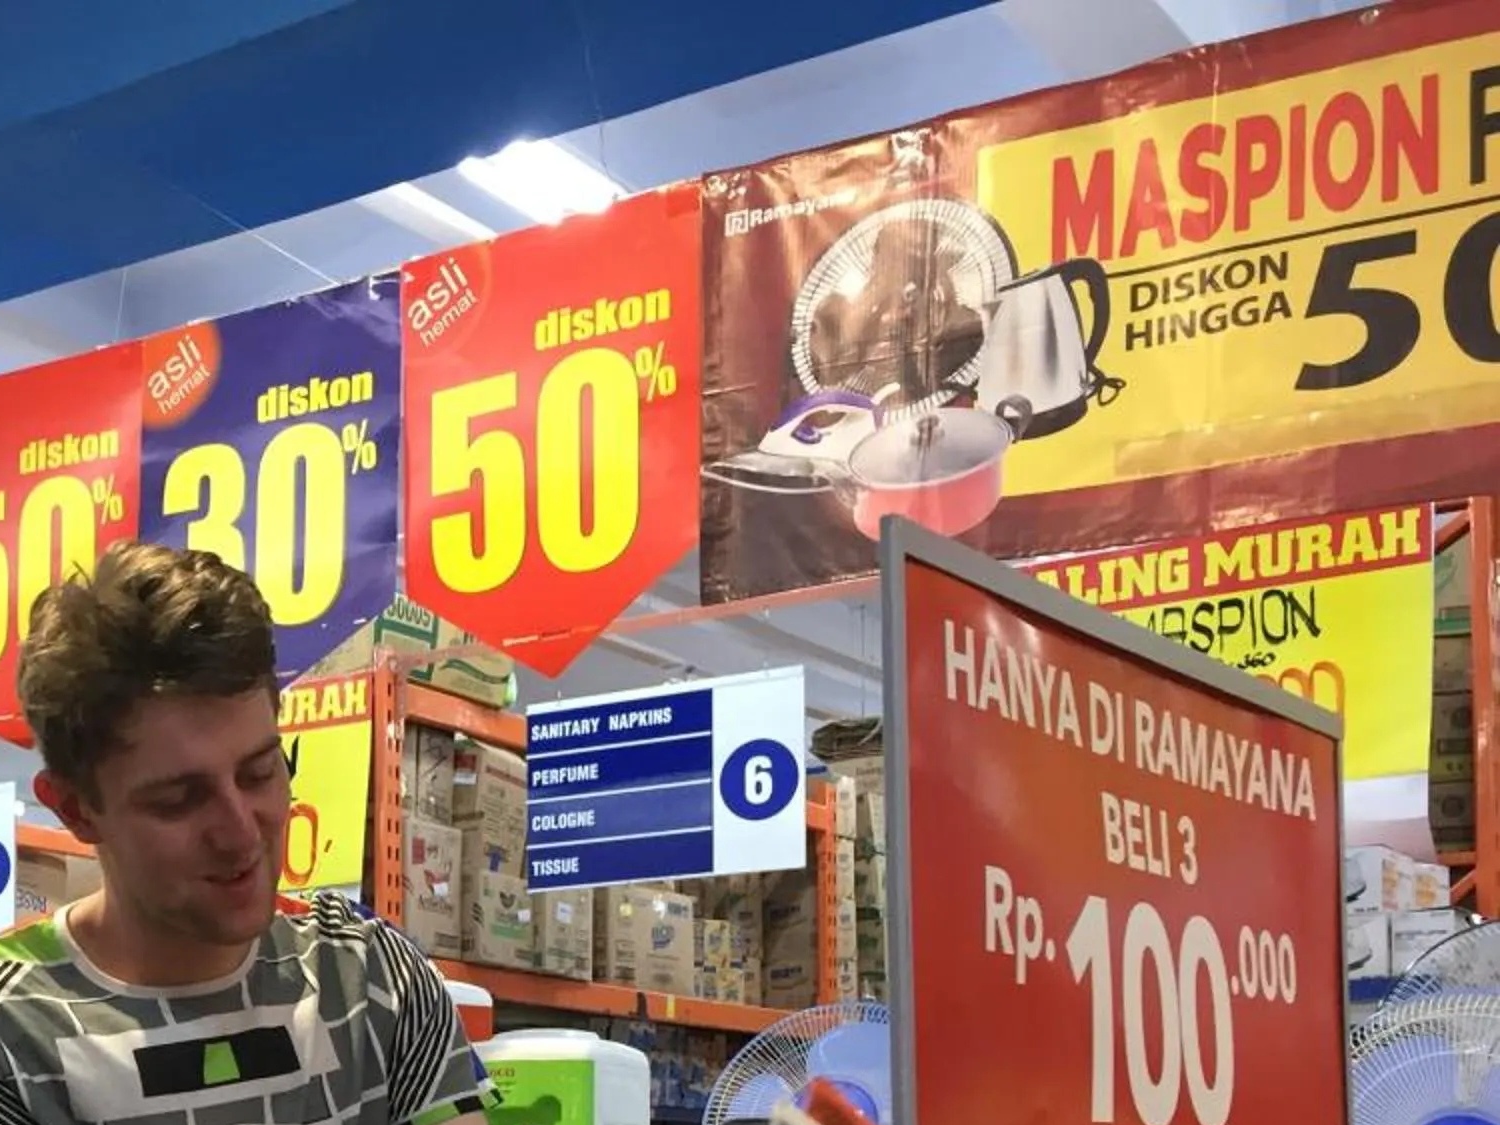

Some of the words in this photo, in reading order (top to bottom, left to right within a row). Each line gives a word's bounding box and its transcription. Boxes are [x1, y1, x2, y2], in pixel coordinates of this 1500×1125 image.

[1051, 72, 1440, 264] MASPION
[407, 257, 469, 331] asli
[1129, 252, 1290, 314] DISKON
[419, 288, 478, 347] hemat
[535, 288, 671, 351] diskon
[1124, 291, 1293, 352] HINGGA
[148, 335, 202, 400] asli
[157, 363, 211, 416] hemat
[257, 371, 373, 424] diskon
[19, 429, 119, 475] diskon
[1203, 507, 1421, 587] MURAH
[1146, 584, 1322, 654] ASPION
[531, 717, 600, 741] SANITARY
[608, 707, 673, 731] NAPKINS
[944, 619, 1083, 749] HANYA
[1090, 682, 1125, 763] DI
[1136, 697, 1317, 821] RAMAYANA
[532, 763, 600, 786] PERFUME
[744, 756, 774, 805] 6
[531, 809, 596, 832] COLOGNE
[1102, 791, 1172, 877] BELI
[1178, 815, 1199, 885] 3
[531, 857, 580, 877] TISSUE
[985, 865, 1056, 985] Rp.
